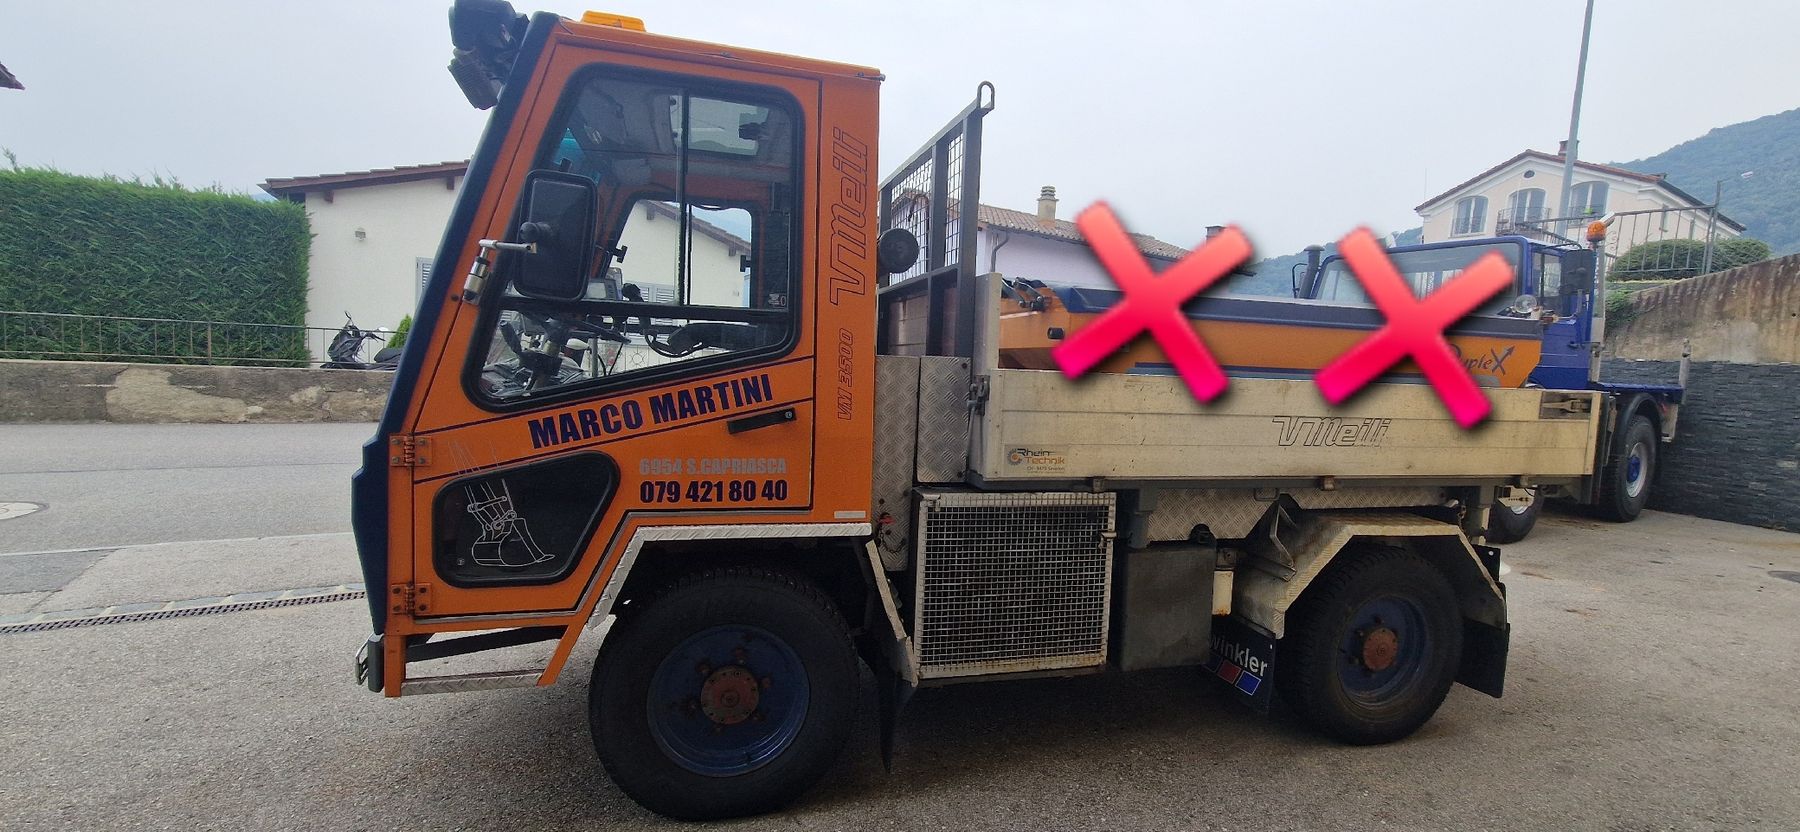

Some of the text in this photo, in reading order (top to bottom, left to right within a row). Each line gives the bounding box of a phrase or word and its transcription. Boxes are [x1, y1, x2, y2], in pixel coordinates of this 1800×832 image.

[837, 327, 854, 420] VM 3500
[528, 374, 773, 449] MARCO MARTINI
[1017, 448, 1051, 457] Rhein
[1024, 456, 1065, 465] Technik
[639, 458, 682, 475] 6954
[640, 479, 788, 503] 079 421 80 40
[1208, 634, 1268, 677] winkler
